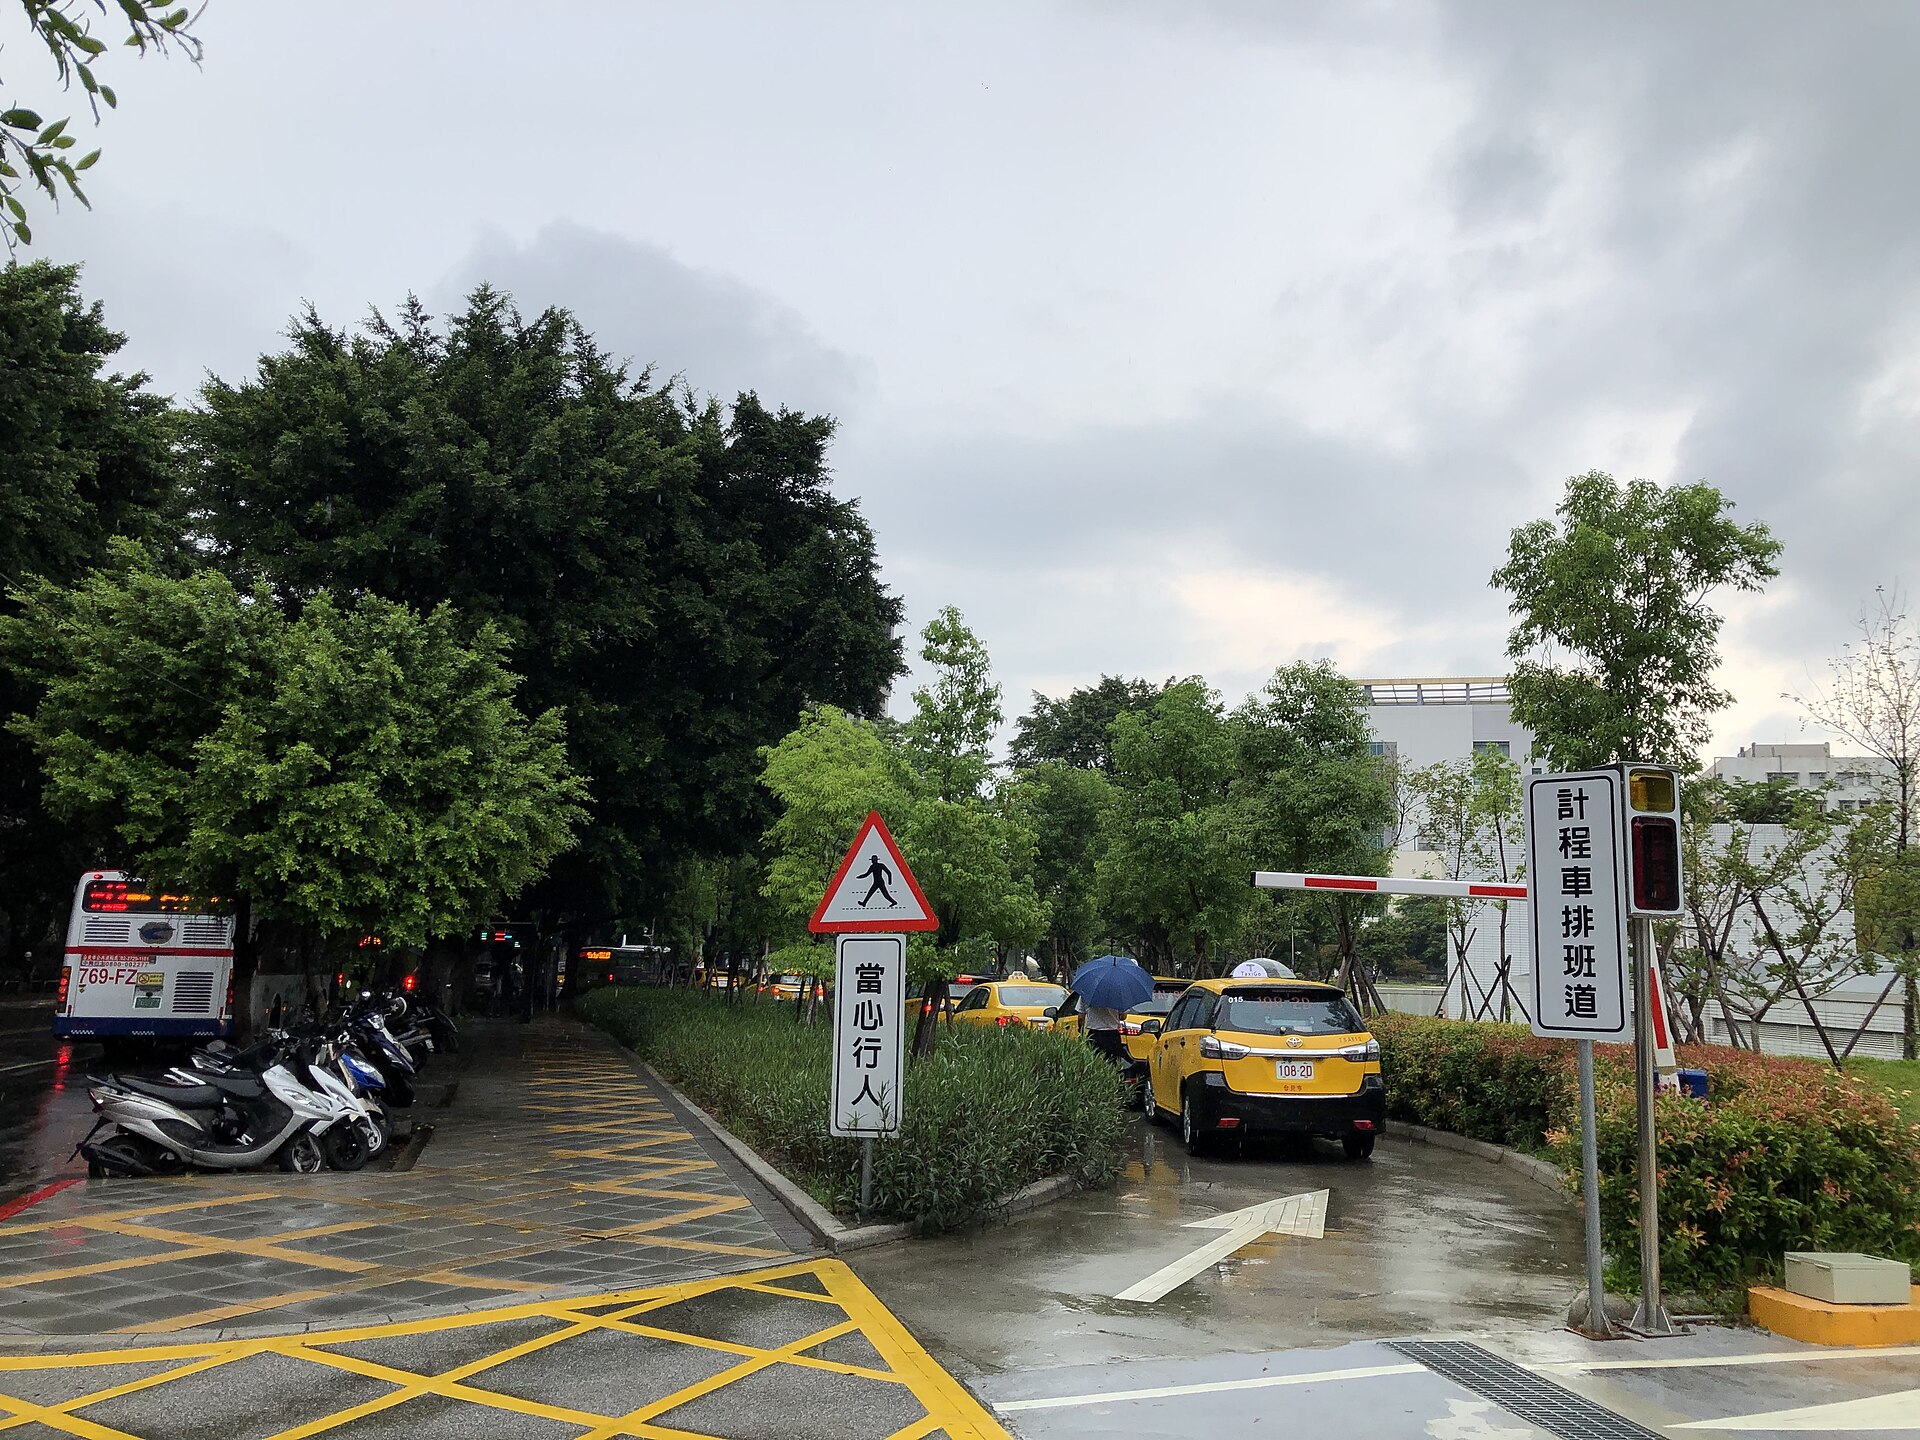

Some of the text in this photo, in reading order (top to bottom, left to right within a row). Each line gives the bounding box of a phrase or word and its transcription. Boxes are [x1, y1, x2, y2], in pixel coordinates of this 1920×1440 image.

[1557, 788, 1598, 1019] 計程車排班道
[79, 968, 138, 985] 769-FZ
[1228, 996, 1244, 1004] 015
[851, 962, 885, 1107] 當心行人
[1279, 1065, 1312, 1077] 108-2D
